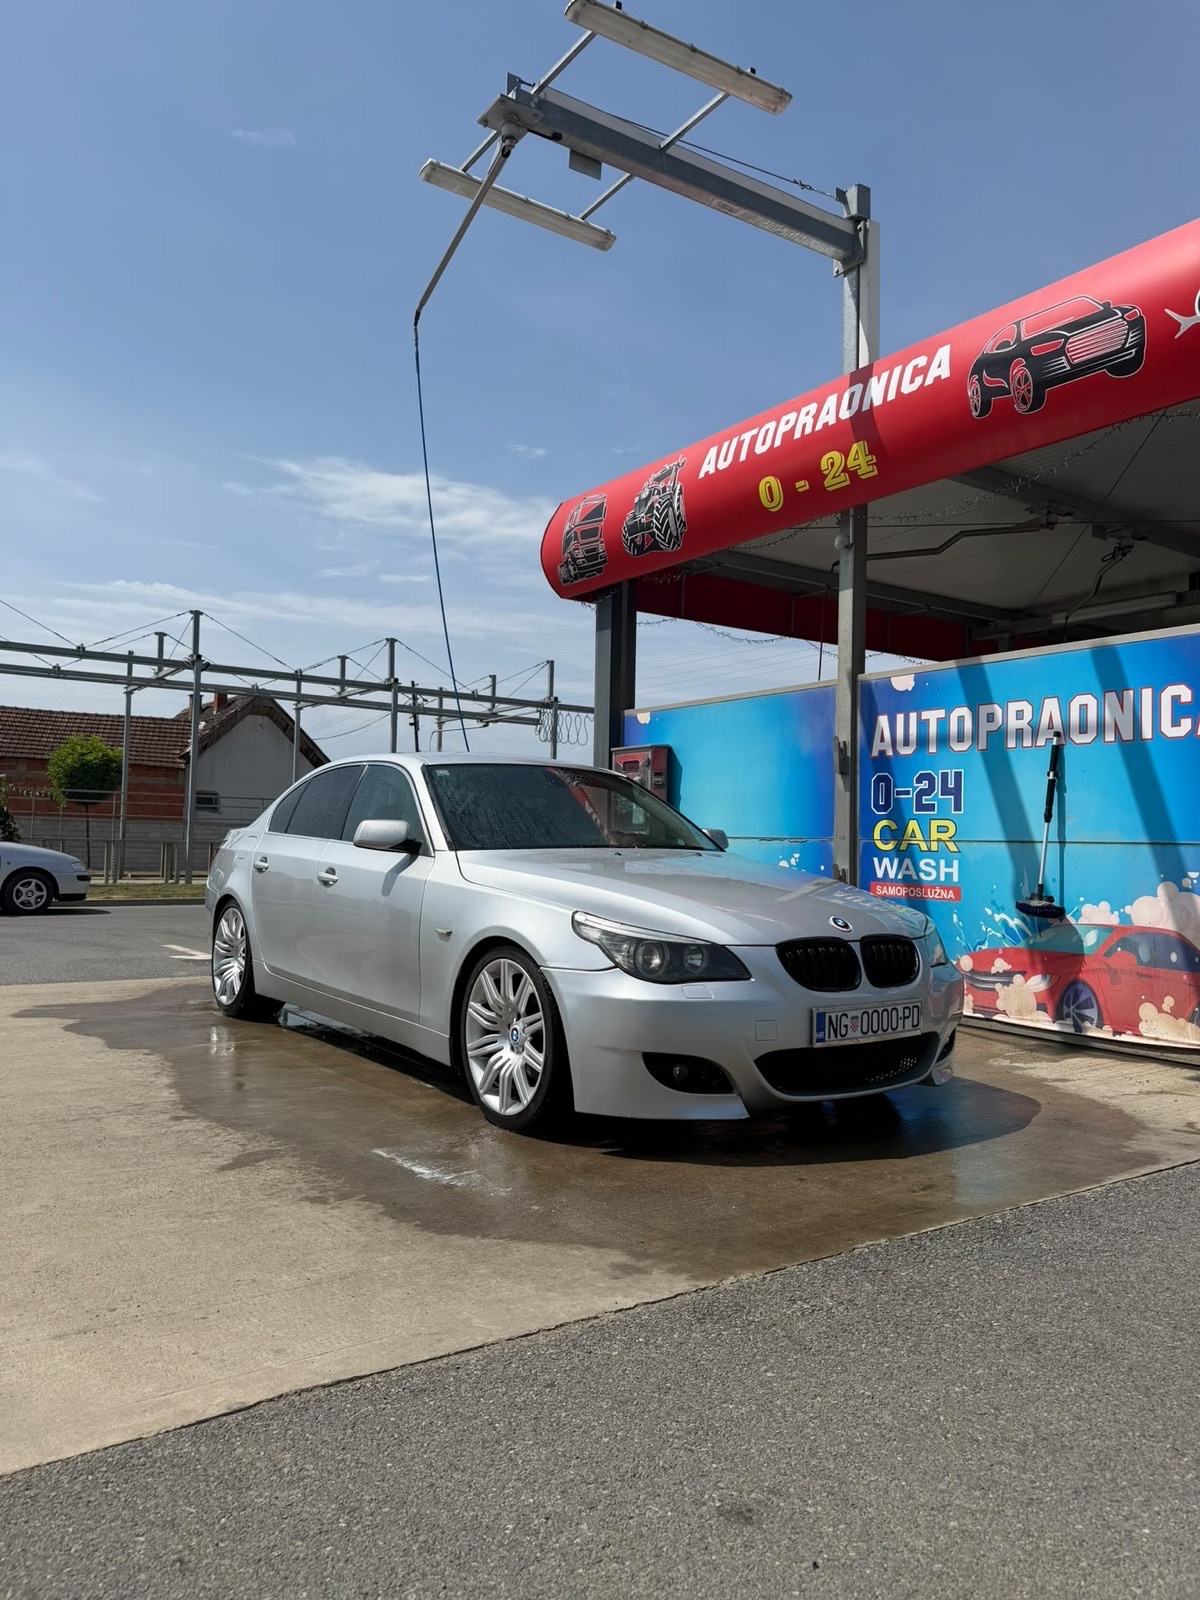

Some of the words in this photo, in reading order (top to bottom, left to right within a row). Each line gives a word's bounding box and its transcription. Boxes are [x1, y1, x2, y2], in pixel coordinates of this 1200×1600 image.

[698, 344, 951, 479] AUTOPRAONICA
[758, 476, 784, 512] 0
[820, 440, 878, 491] 24
[871, 682, 1200, 758] AUTOPRAONIC
[870, 769, 964, 814] 0-24
[872, 819, 960, 853] CAR
[873, 857, 959, 882] WASH
[876, 885, 955, 900] SAMOPOSLUŽNA
[828, 1013, 849, 1039] NG
